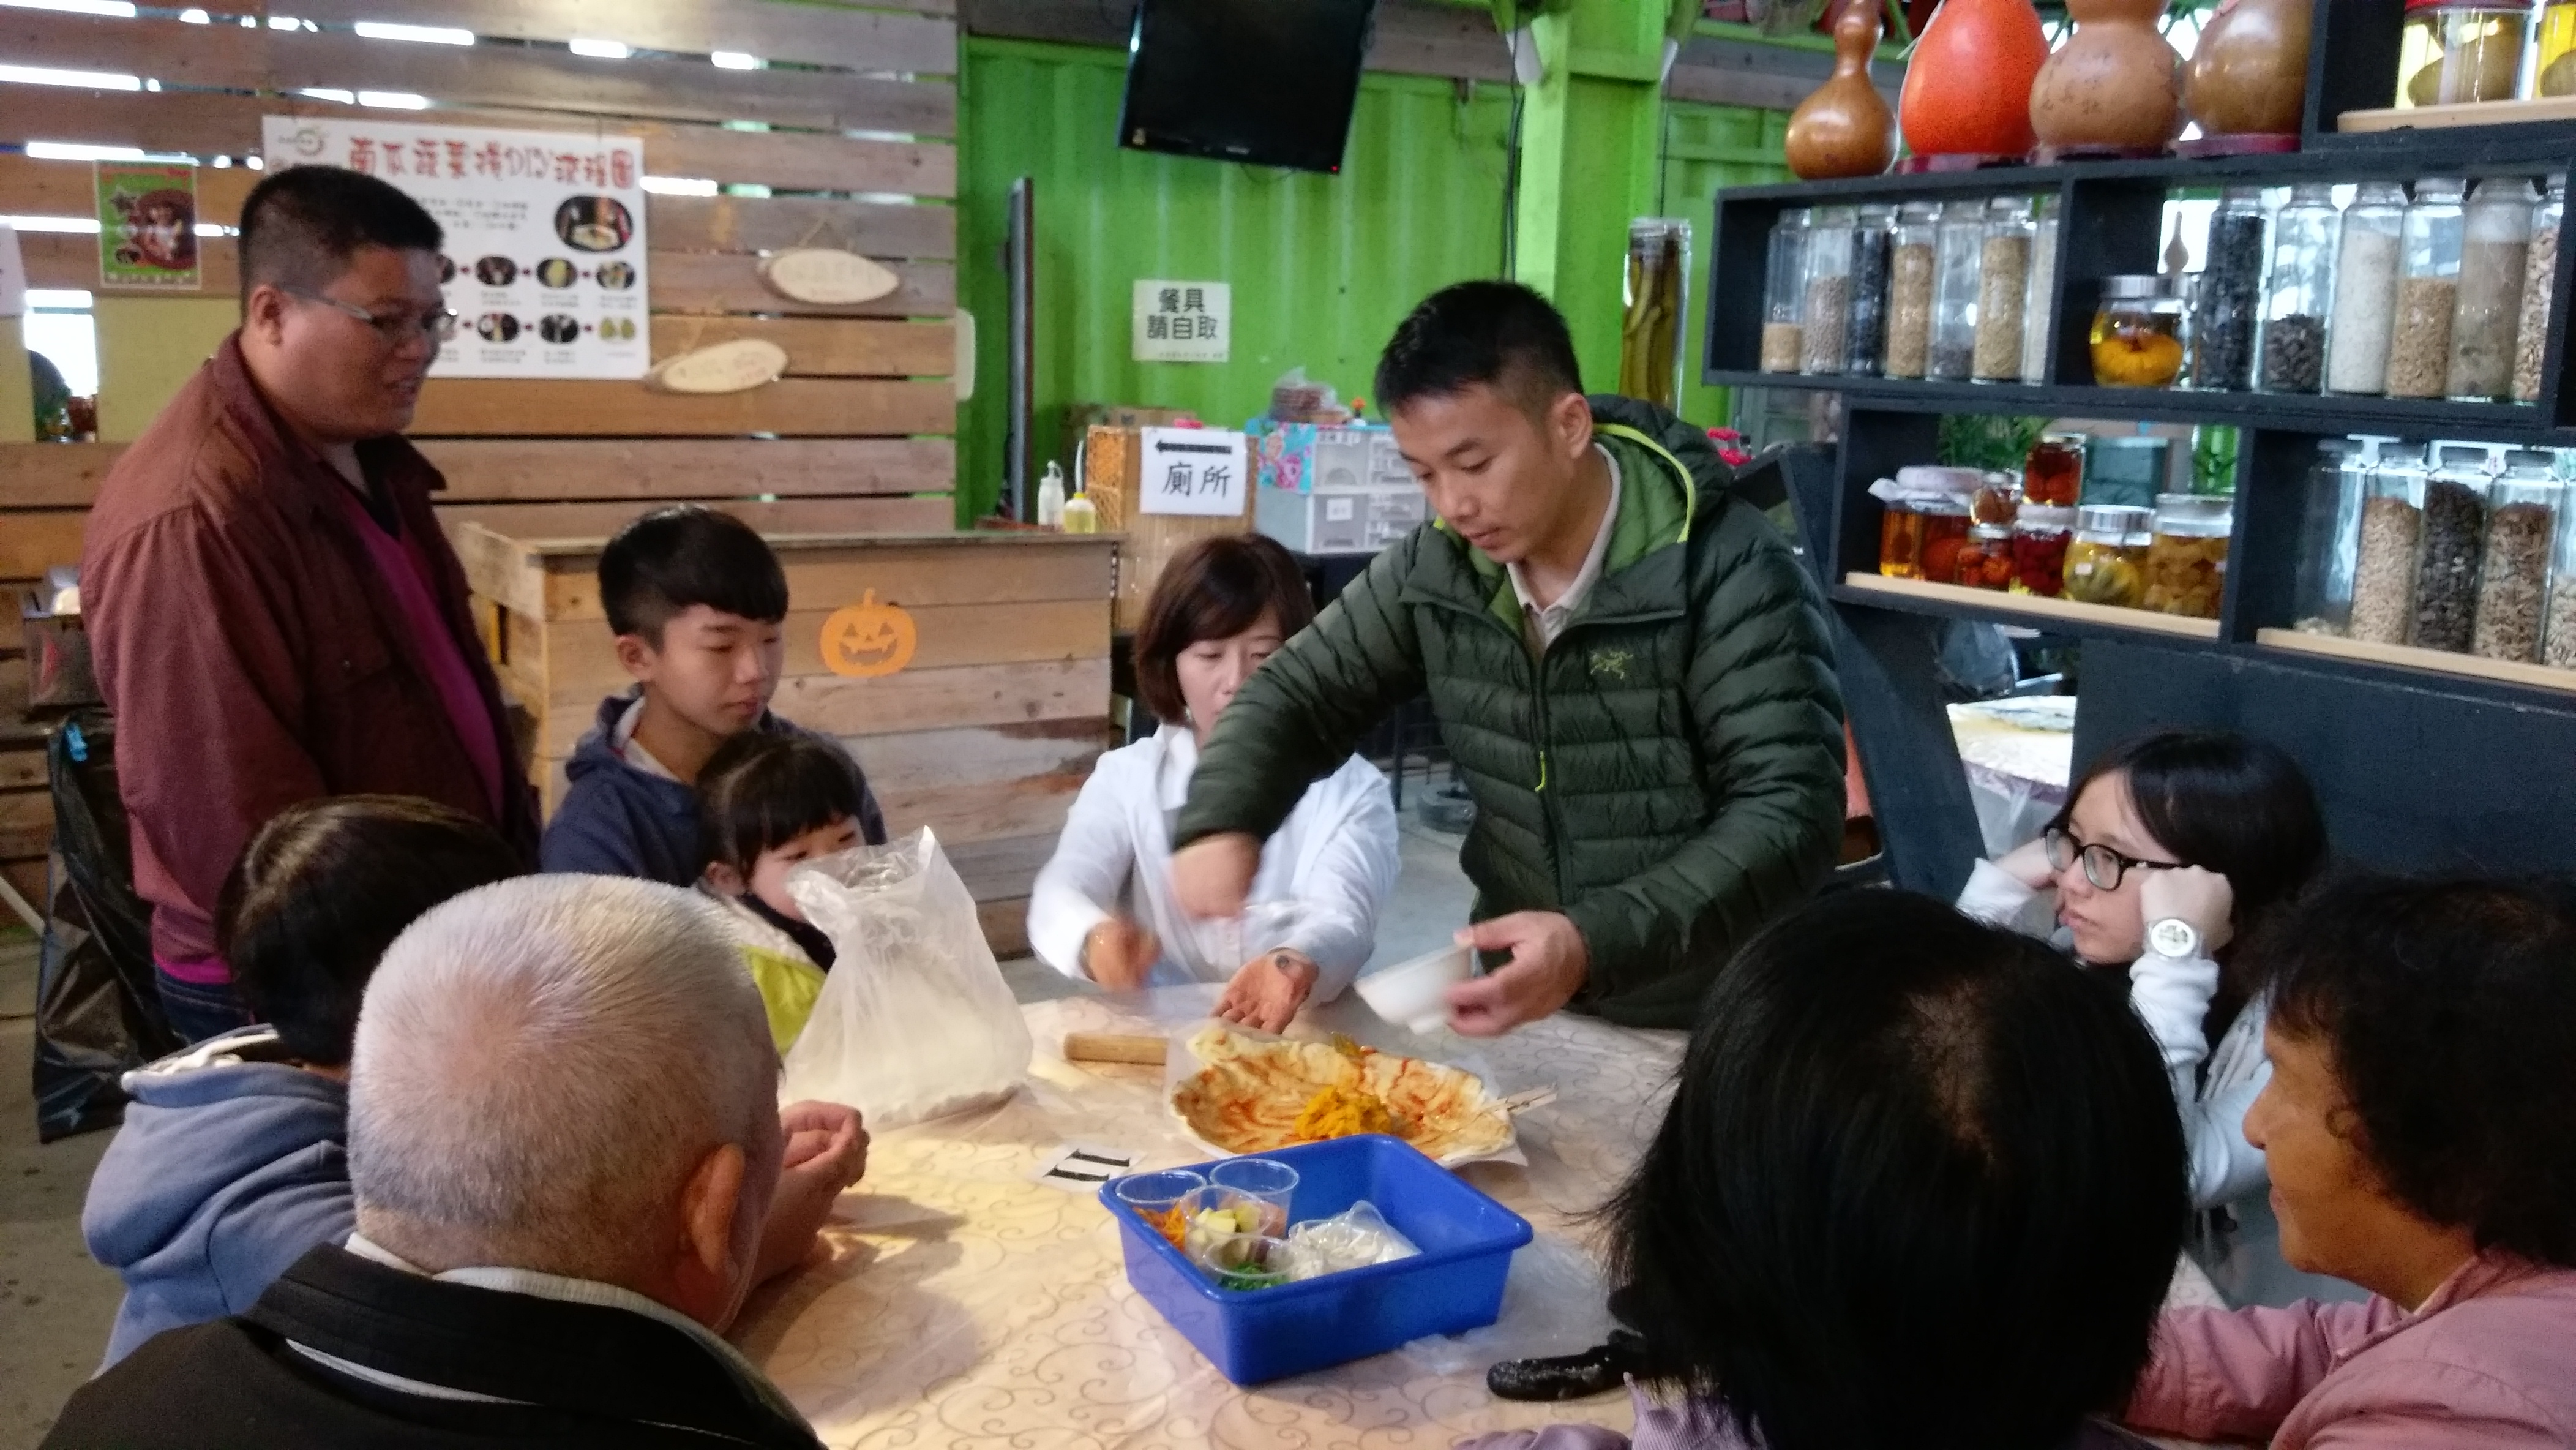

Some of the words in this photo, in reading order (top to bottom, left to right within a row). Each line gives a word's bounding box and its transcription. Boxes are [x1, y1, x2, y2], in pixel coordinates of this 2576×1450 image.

[1159, 288, 1205, 313] 餐具
[1147, 315, 1217, 340] 請自取
[1162, 462, 1231, 498] 廁所
